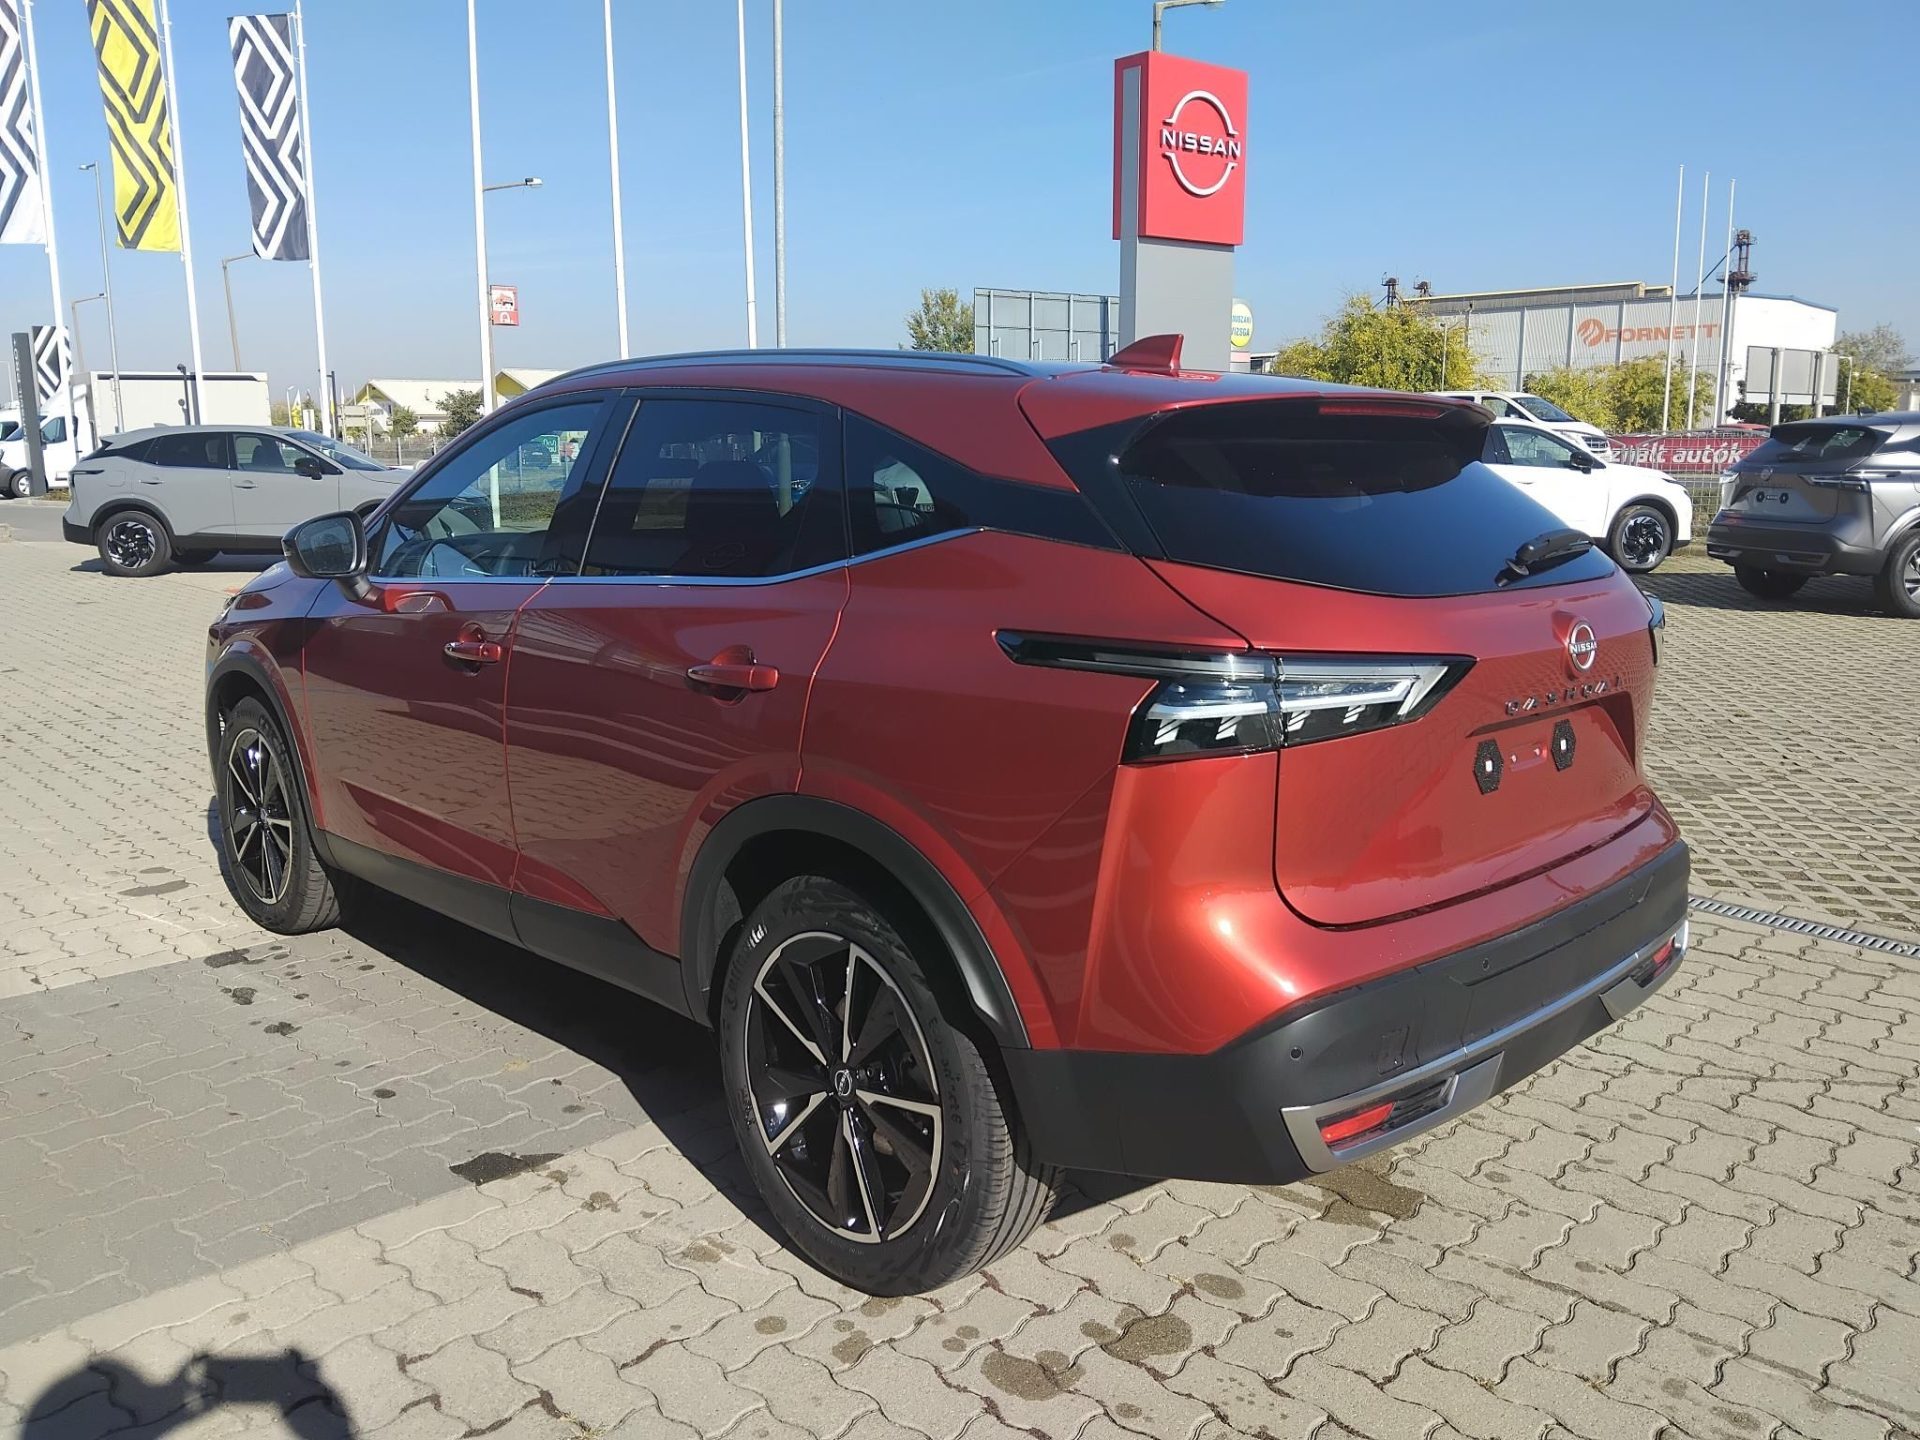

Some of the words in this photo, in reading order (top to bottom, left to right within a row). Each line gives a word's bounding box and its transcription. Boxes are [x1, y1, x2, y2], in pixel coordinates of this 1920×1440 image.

[1161, 128, 1241, 158] NISSAN
[1611, 441, 1668, 464] znált
[1672, 441, 1744, 464] autók
